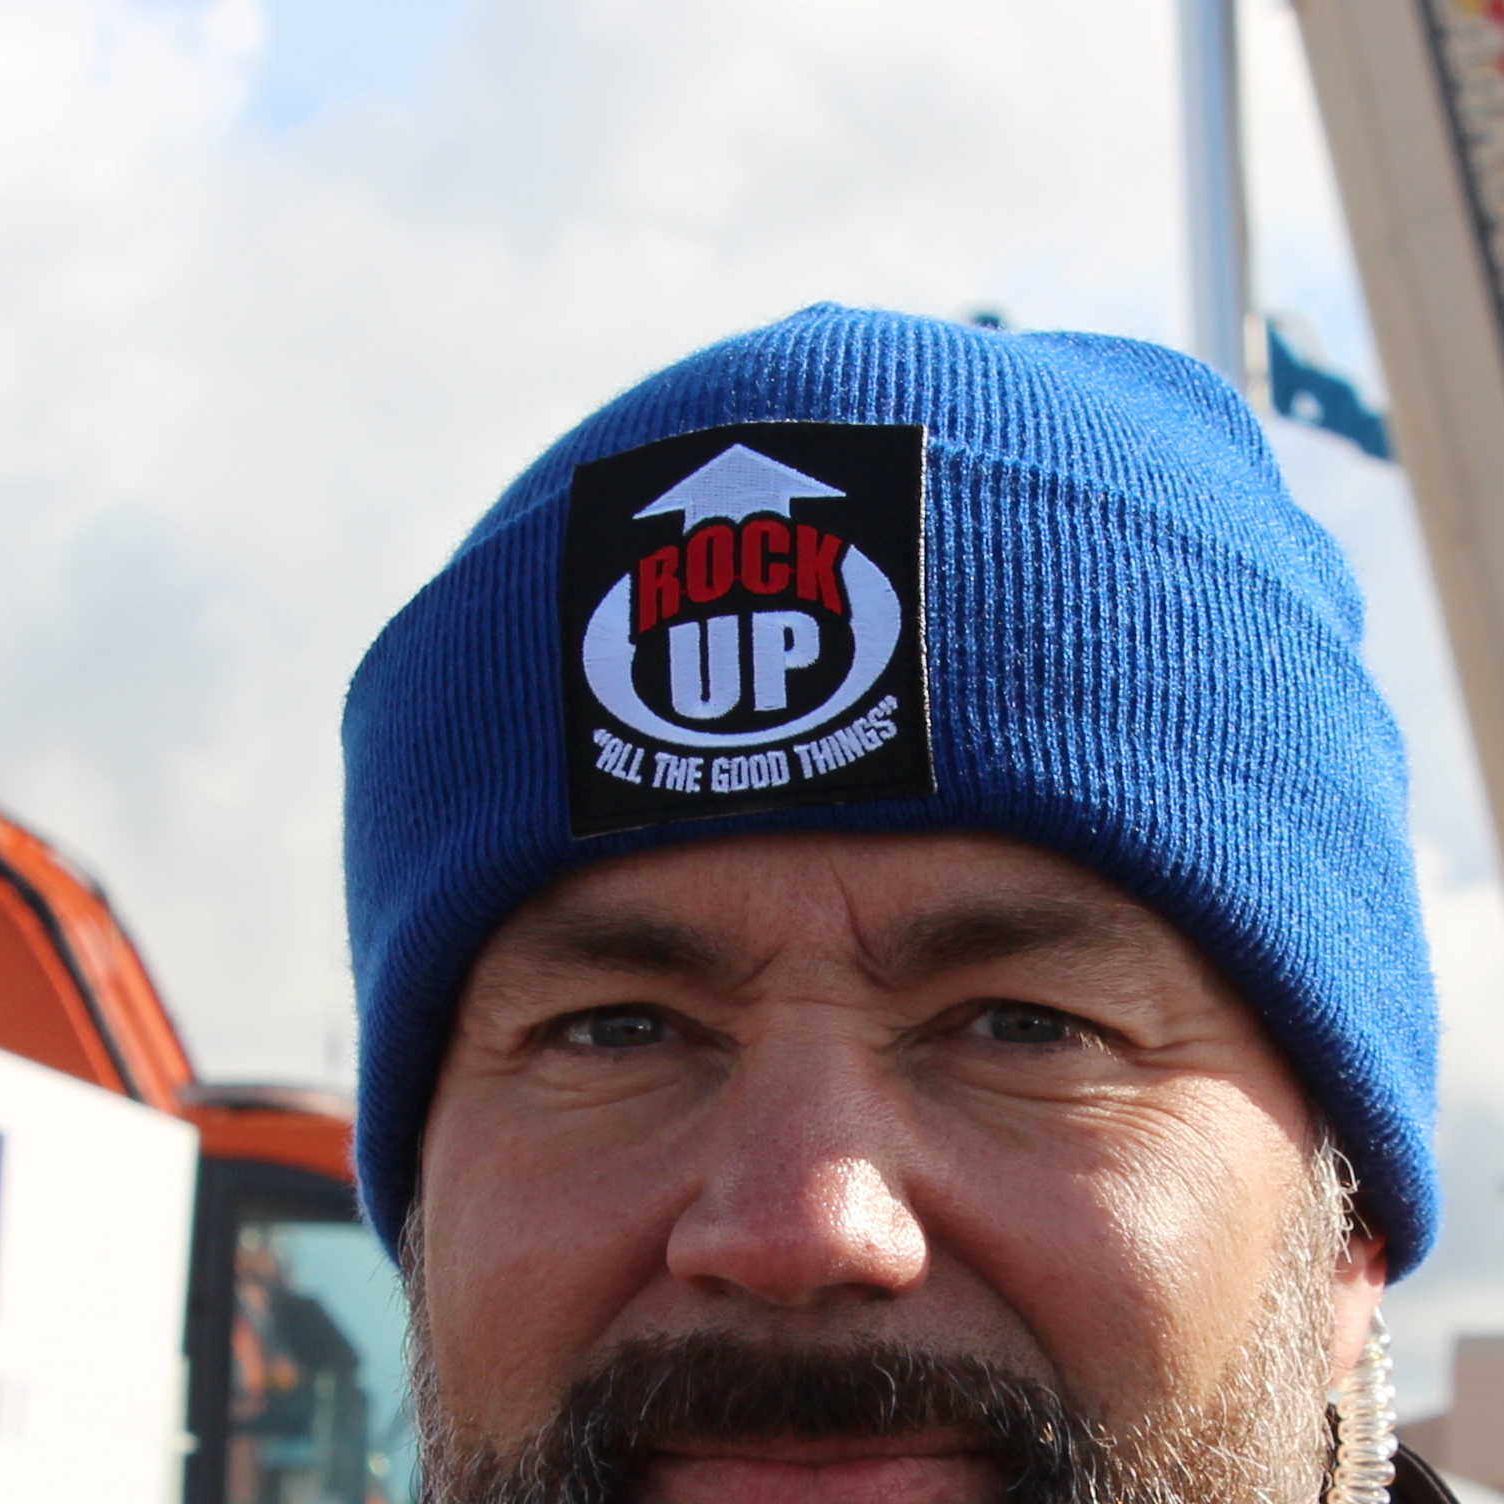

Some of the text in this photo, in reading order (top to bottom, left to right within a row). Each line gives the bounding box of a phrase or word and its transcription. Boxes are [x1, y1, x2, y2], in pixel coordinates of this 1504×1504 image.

[638, 519, 842, 633] ROCK
[669, 610, 820, 719] UP
[652, 750, 703, 793] THE
[710, 749, 789, 793] GOOD
